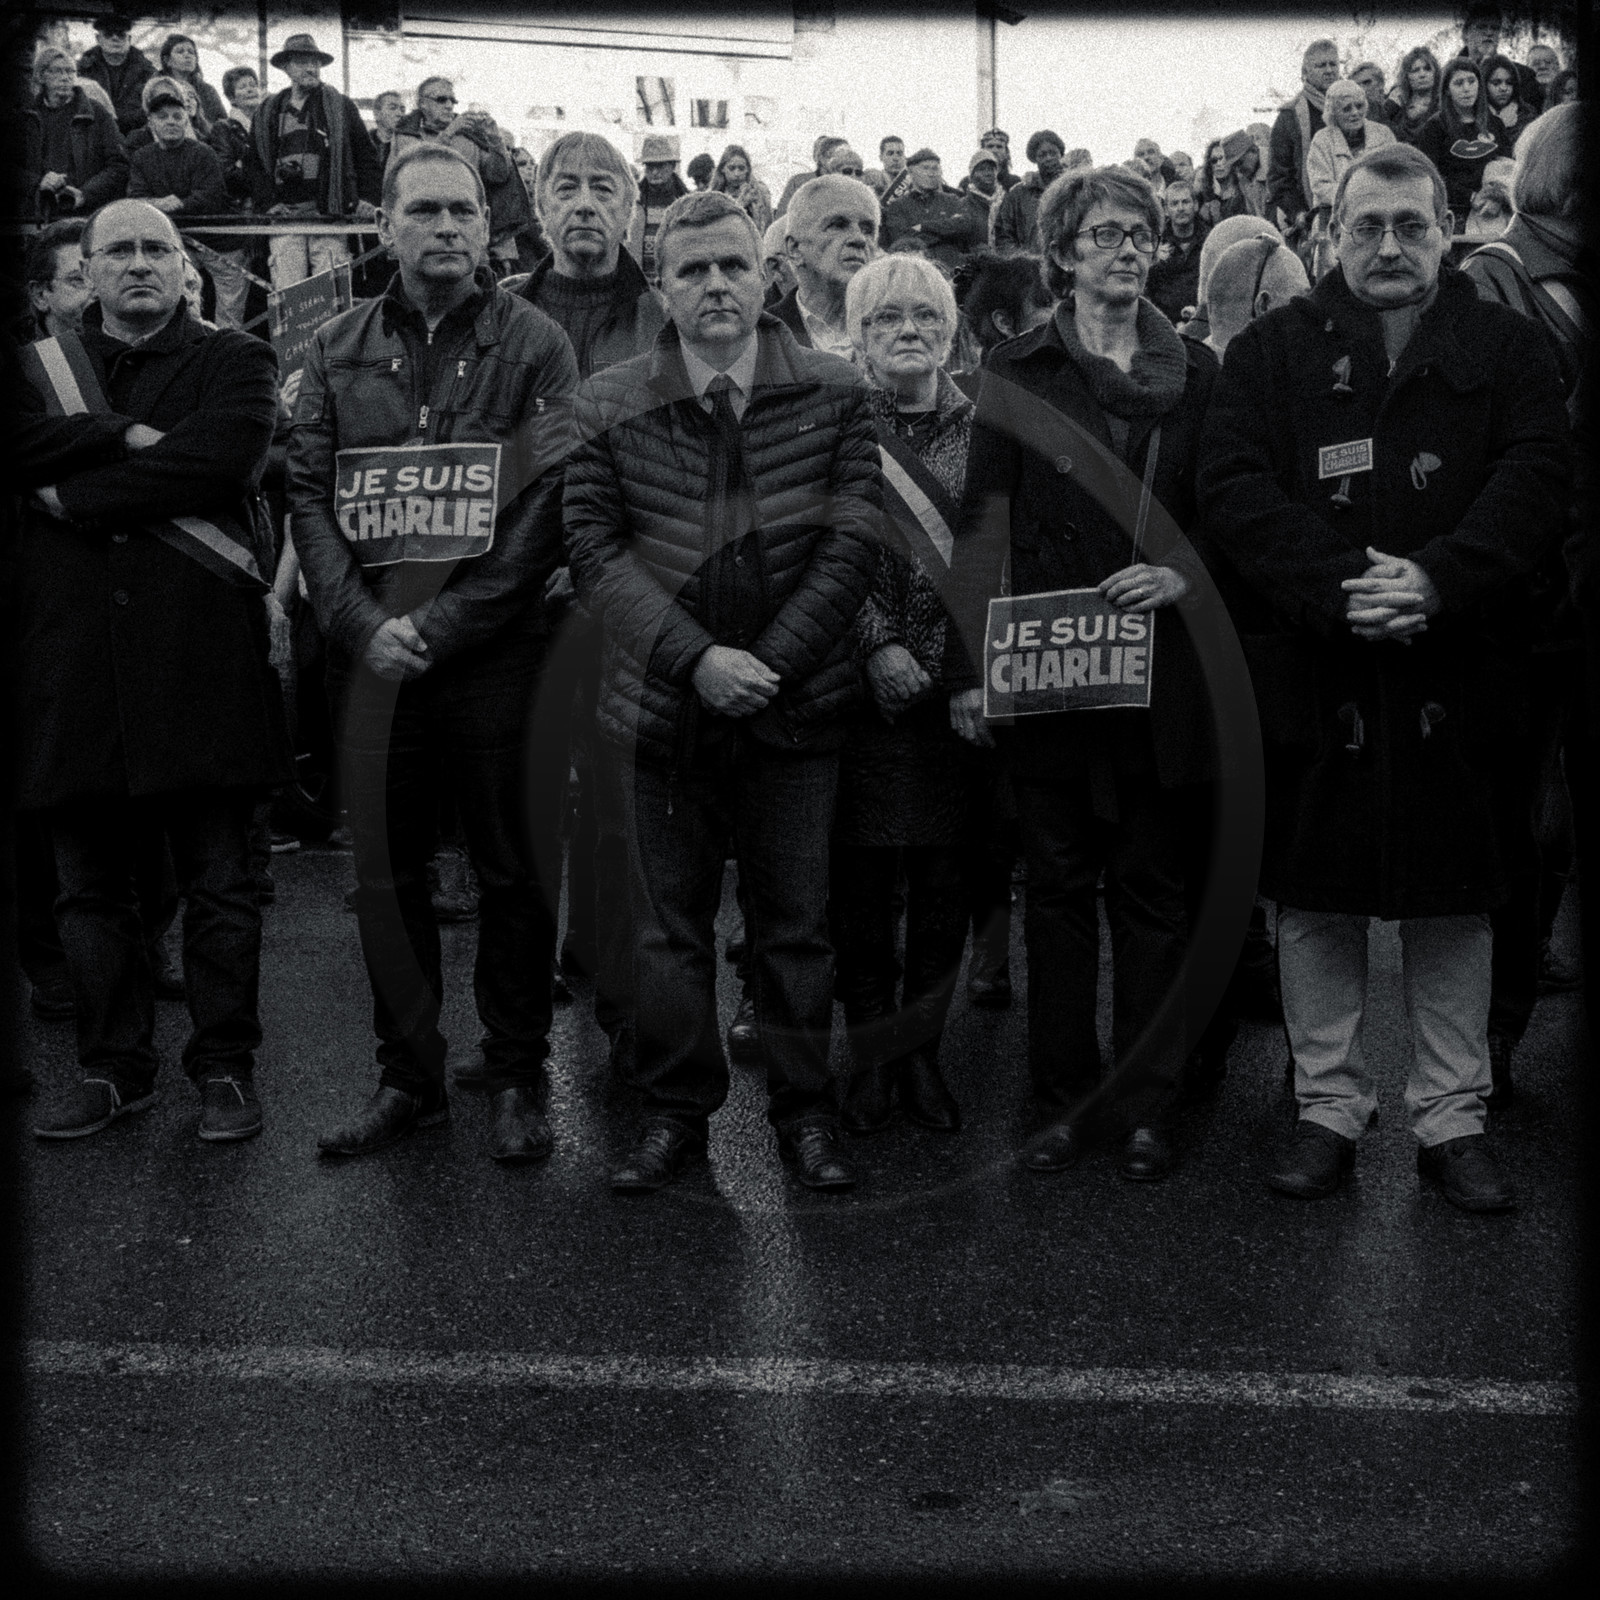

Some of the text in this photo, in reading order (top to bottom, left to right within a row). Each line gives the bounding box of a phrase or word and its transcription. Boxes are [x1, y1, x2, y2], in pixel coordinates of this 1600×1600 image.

[1323, 443, 1367, 461] JE SUIS
[1324, 452, 1369, 471] CHARLIE
[338, 463, 493, 498] JE SUIS
[338, 495, 493, 542] CHARLIE
[992, 613, 1147, 650] JE SUIS
[990, 646, 1147, 693] CHARLIE
